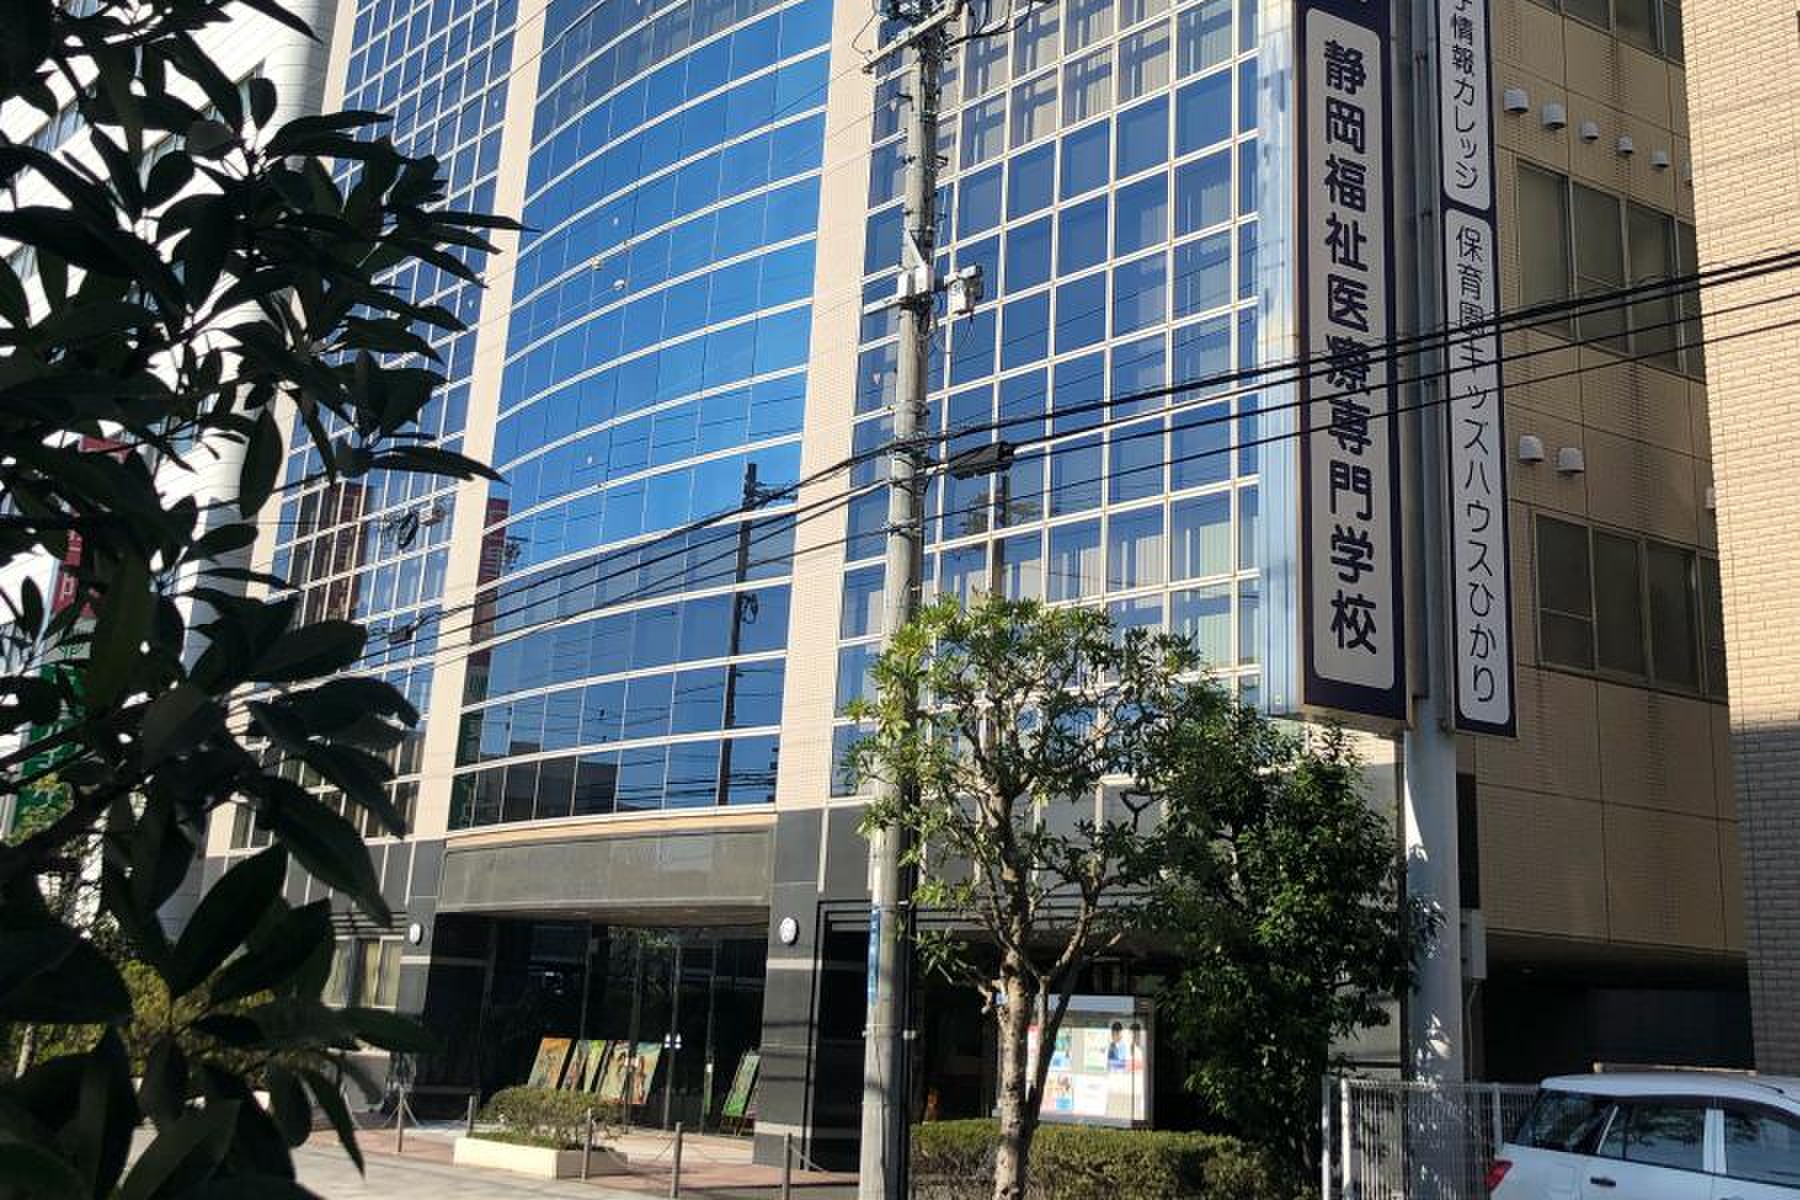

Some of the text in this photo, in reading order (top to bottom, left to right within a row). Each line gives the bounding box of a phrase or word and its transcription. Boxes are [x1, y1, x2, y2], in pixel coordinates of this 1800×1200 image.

[1322, 38, 1378, 655] 静岡福祉医療専門学校
[1455, 223, 1498, 703] 保育園キッズハウスひかり
